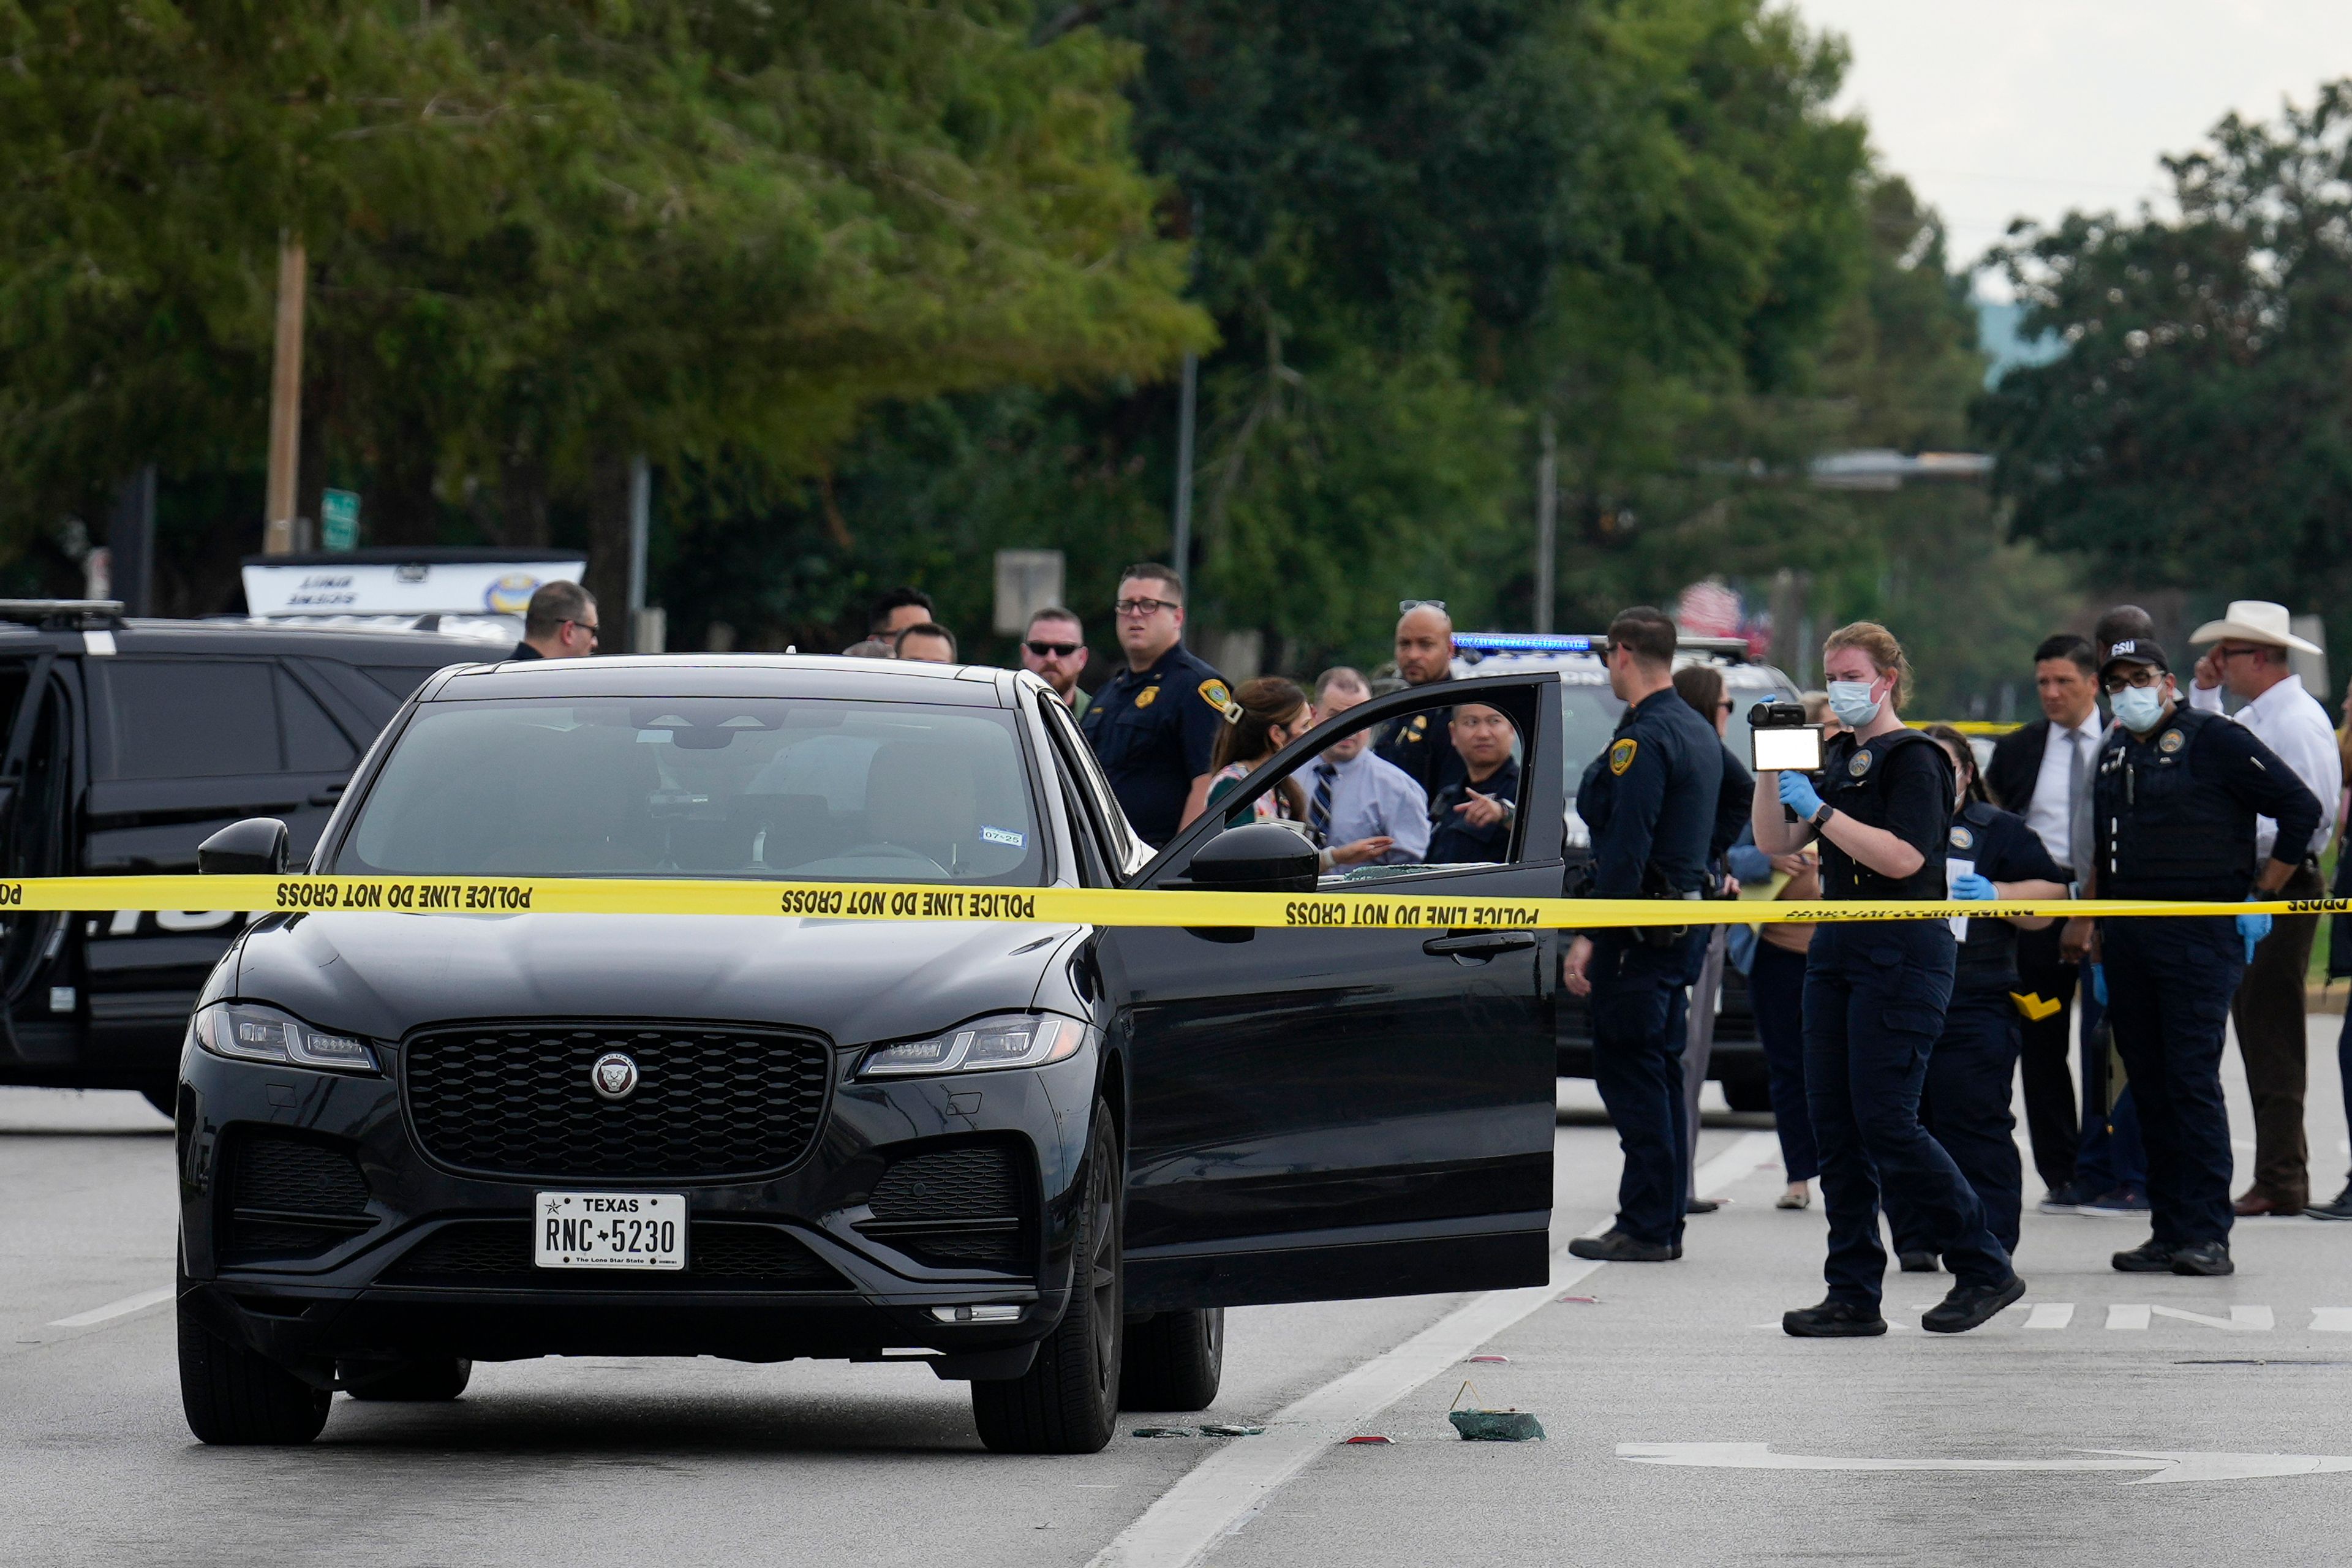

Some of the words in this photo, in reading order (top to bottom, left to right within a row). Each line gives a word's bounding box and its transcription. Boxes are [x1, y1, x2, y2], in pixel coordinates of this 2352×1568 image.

[276, 883, 338, 908] CROSS
[343, 884, 382, 908] NOT
[387, 884, 415, 908] DO
[418, 885, 461, 908] LINE
[466, 885, 533, 909] POLICE
[782, 890, 843, 914] CROSS
[846, 891, 887, 915] NOT
[892, 892, 918, 916] DO
[922, 892, 964, 916] LINE
[970, 894, 1035, 918] POLICE
[1286, 902, 1346, 925] CROSS
[1351, 903, 1389, 925] NOT
[1395, 905, 1420, 925] DO
[1427, 907, 1468, 925] LINE
[597, 1054, 634, 1067] JAGUAR
[583, 1199, 639, 1213] TEXAS
[546, 1219, 593, 1251] RNC
[612, 1219, 674, 1253] 5230
